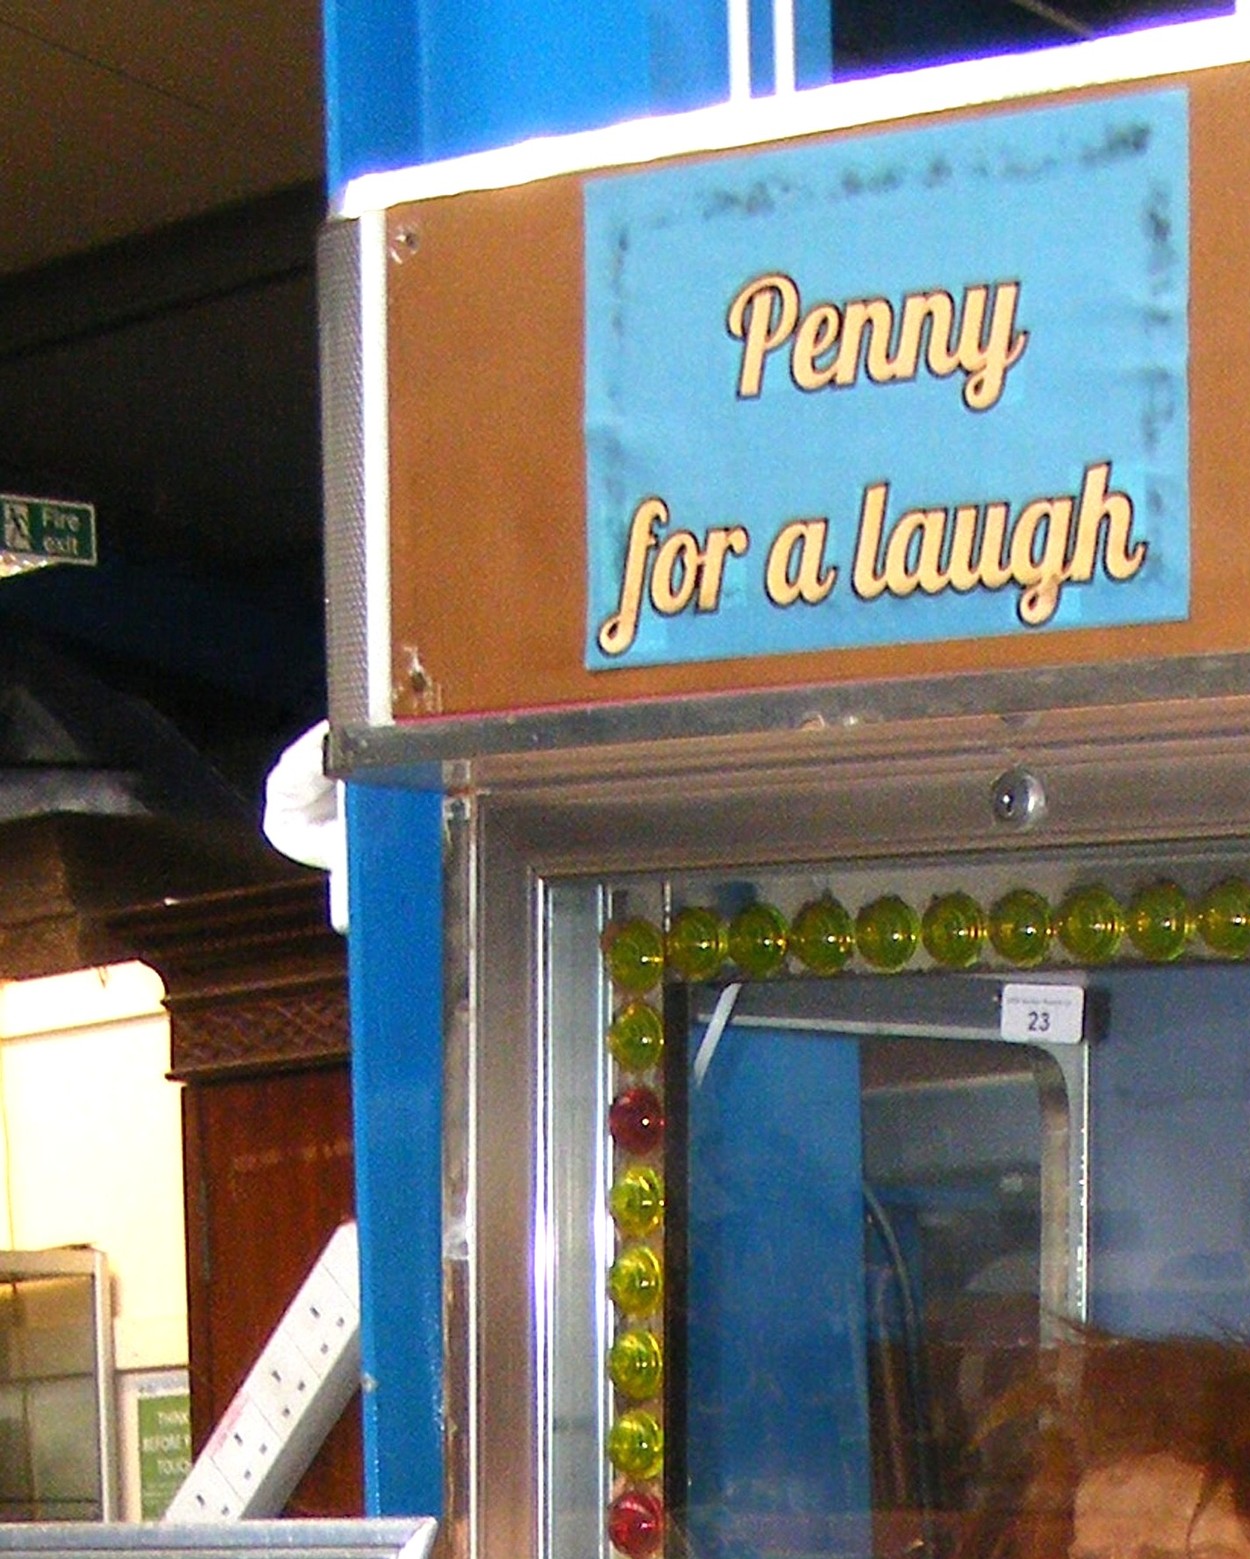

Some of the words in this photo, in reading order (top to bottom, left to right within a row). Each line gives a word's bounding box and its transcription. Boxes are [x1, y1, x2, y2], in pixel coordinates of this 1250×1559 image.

[727, 272, 1028, 412] Penny
[42, 503, 80, 532] Fire
[598, 497, 747, 657] for
[765, 517, 837, 609] a
[851, 460, 1148, 626] laugh
[1028, 1011, 1050, 1032] 23
